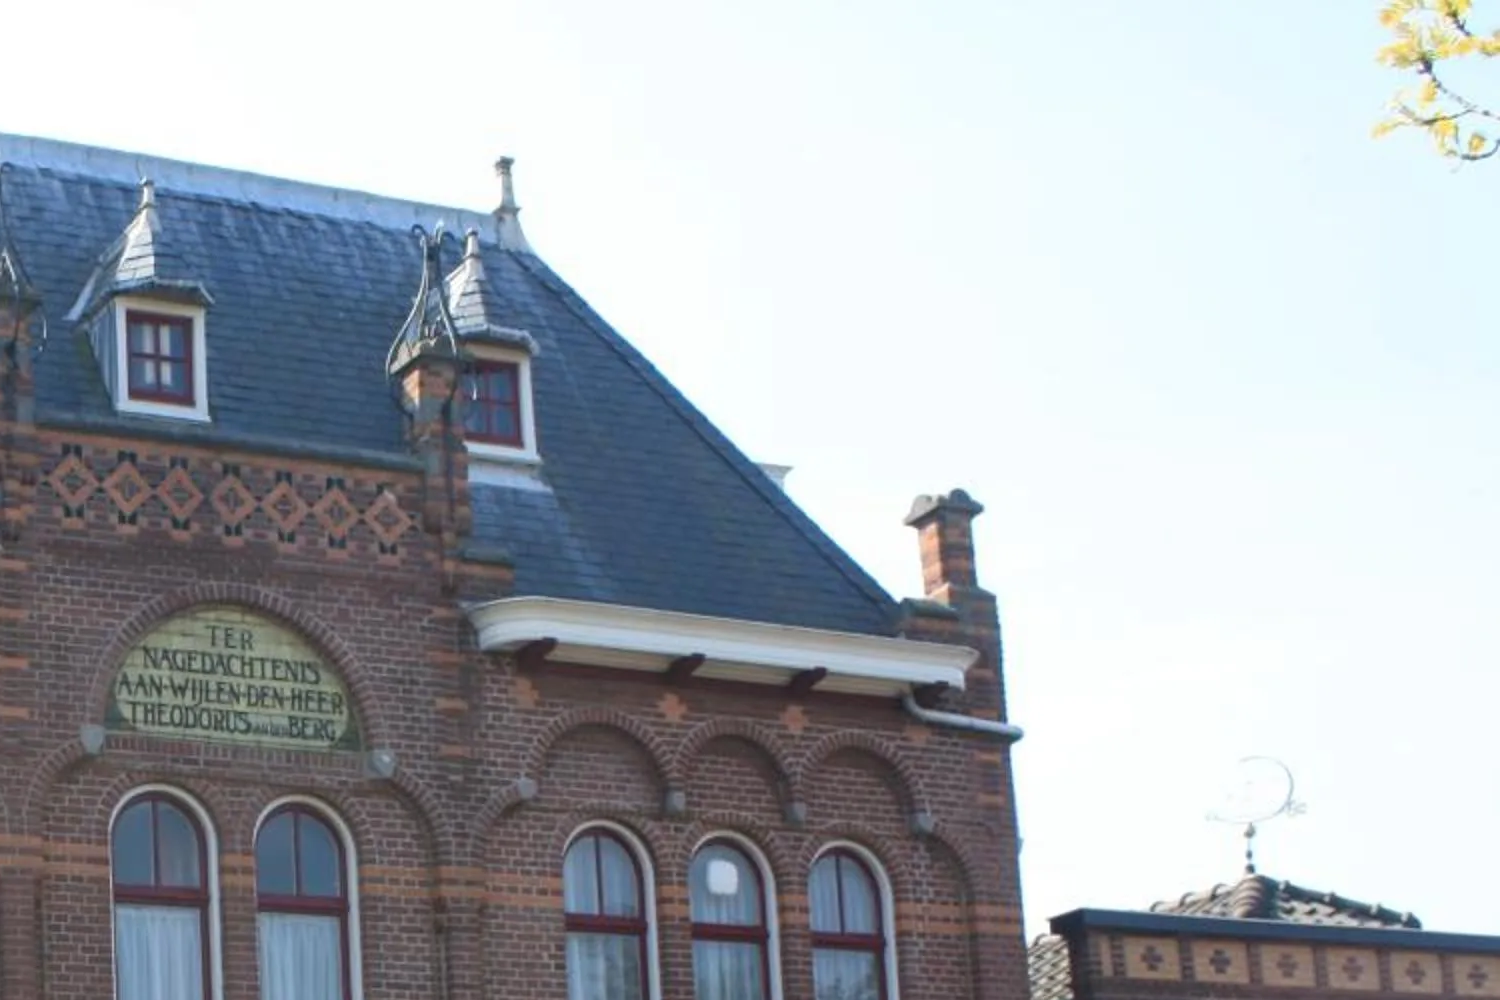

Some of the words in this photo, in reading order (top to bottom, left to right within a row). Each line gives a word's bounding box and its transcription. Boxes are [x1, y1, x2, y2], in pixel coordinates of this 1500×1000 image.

[205, 625, 254, 651] TER
[143, 646, 321, 685] NAGEDACHTENIS
[118, 672, 163, 698] AAN
[246, 685, 285, 711] DEN
[290, 687, 343, 715] HEER
[127, 701, 252, 735] THEODORUS
[288, 715, 336, 742] BERG
